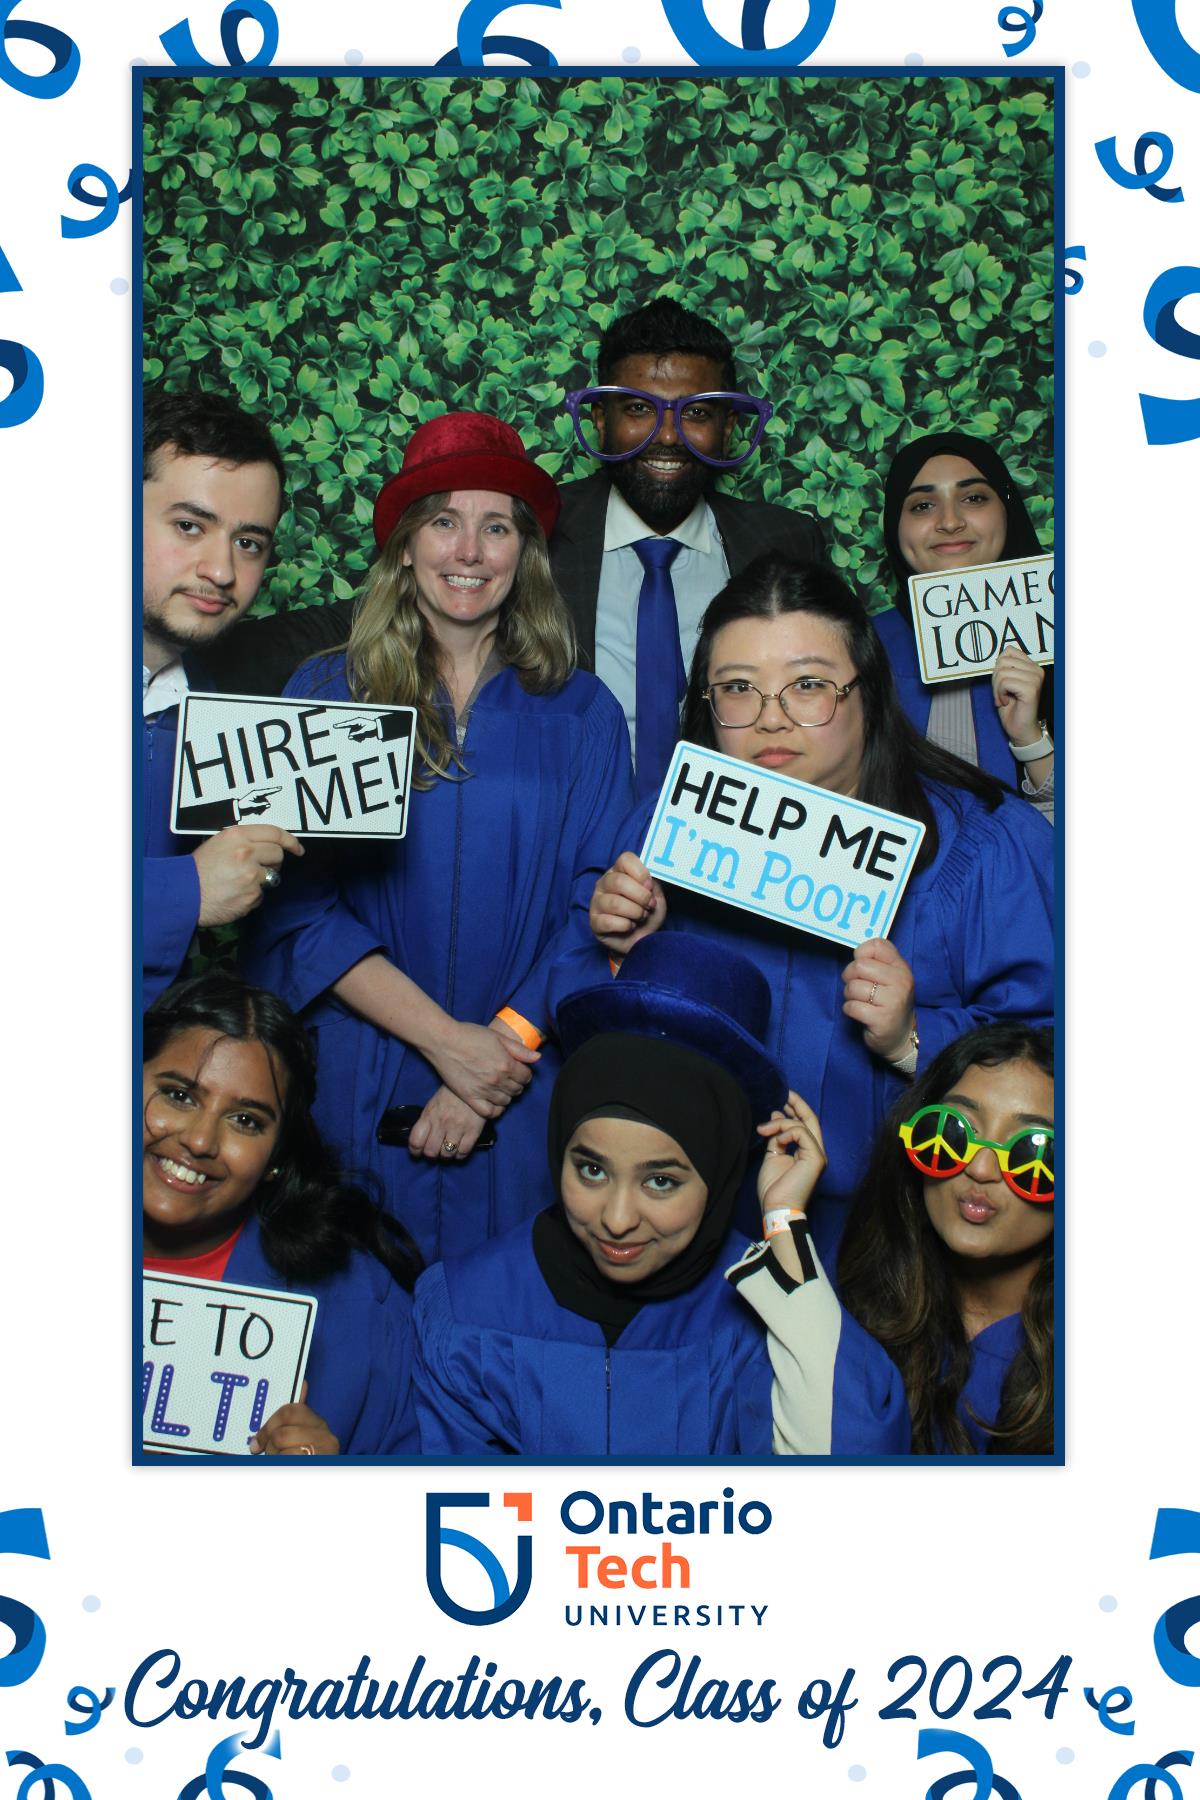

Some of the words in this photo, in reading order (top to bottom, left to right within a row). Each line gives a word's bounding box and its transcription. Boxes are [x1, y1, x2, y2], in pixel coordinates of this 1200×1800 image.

[922, 571, 1042, 618] GAME
[184, 706, 337, 798] HIRE
[295, 752, 404, 831] ME!
[670, 762, 807, 840] HELP
[819, 814, 908, 882] ME
[653, 815, 740, 890] I'm
[751, 850, 887, 938] Poor!
[143, 1298, 183, 1346] E
[205, 1303, 274, 1360] TO
[143, 1361, 269, 1445] LT!
